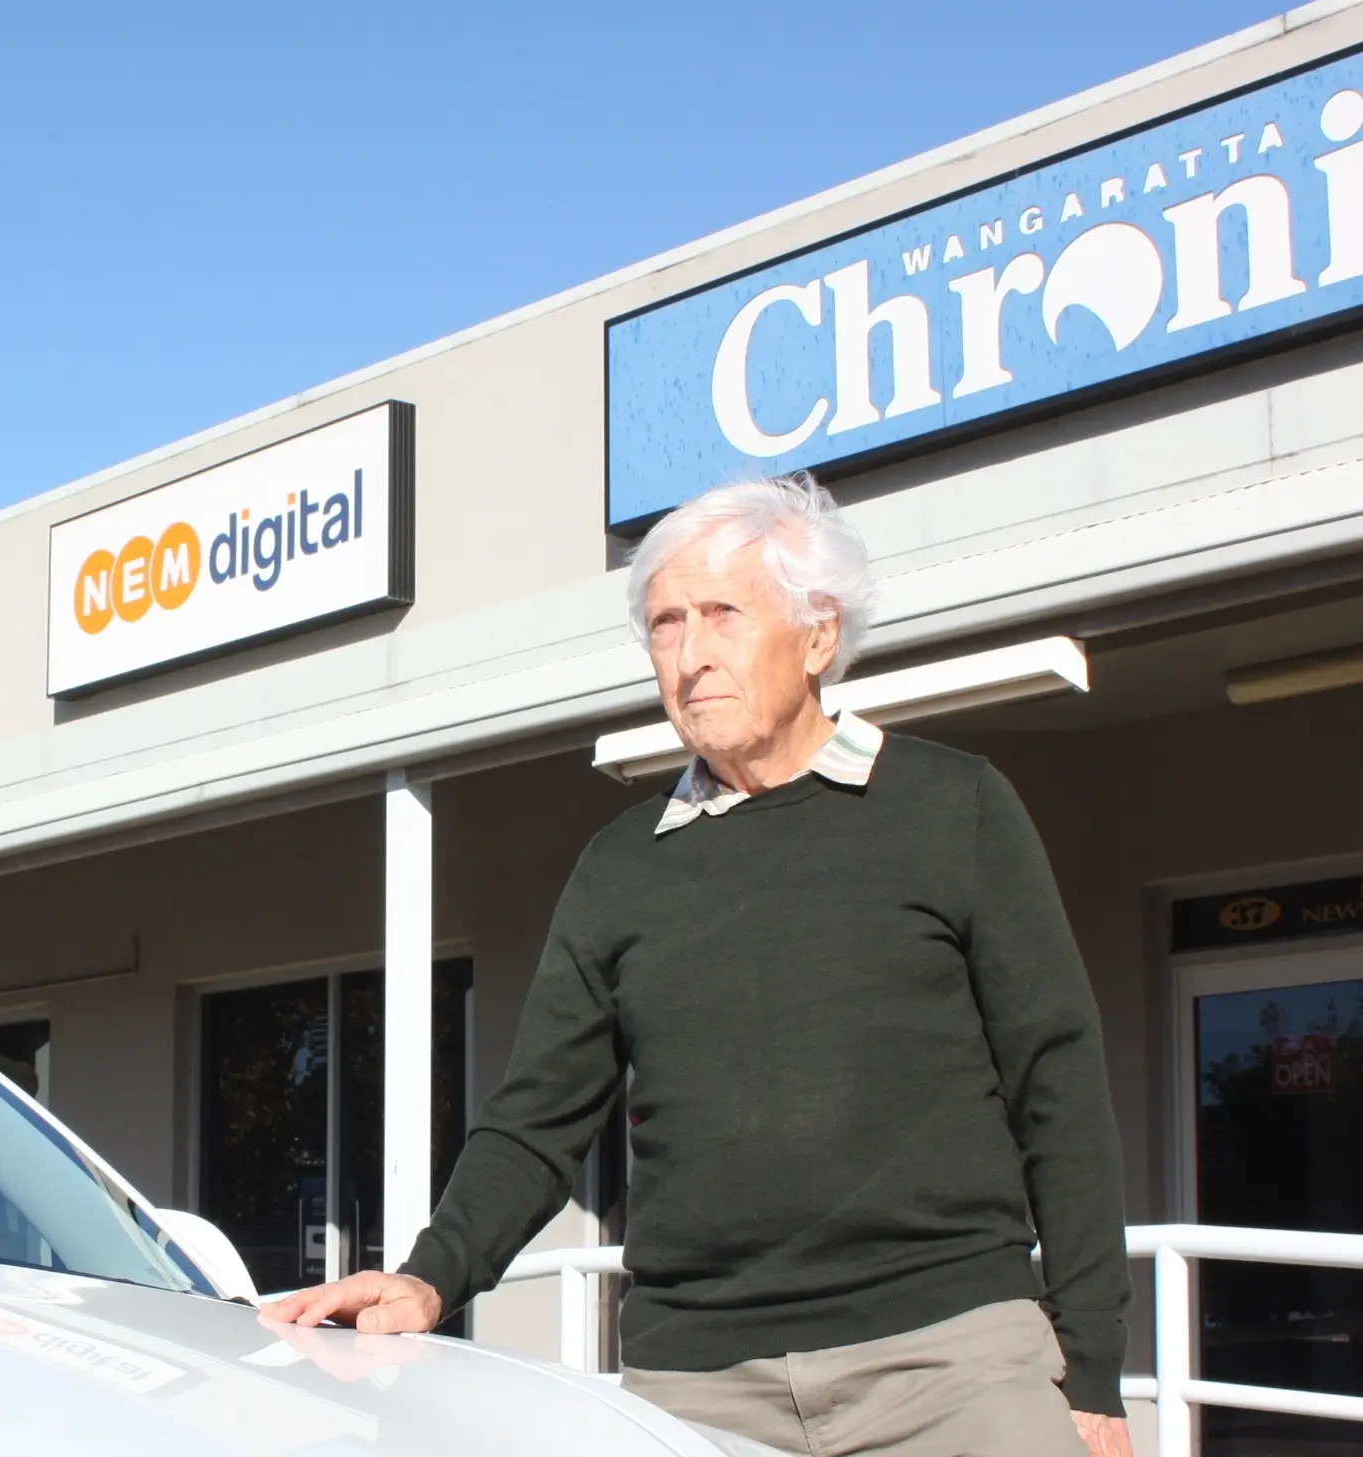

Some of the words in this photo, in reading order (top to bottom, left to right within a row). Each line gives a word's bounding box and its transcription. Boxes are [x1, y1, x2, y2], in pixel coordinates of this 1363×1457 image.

[903, 122, 1284, 276] WANGARATTA
[82, 543, 191, 616] NEM
[209, 467, 363, 592] digital
[1230, 900, 1268, 926] 37
[1275, 1061, 1332, 1087] OPEN
